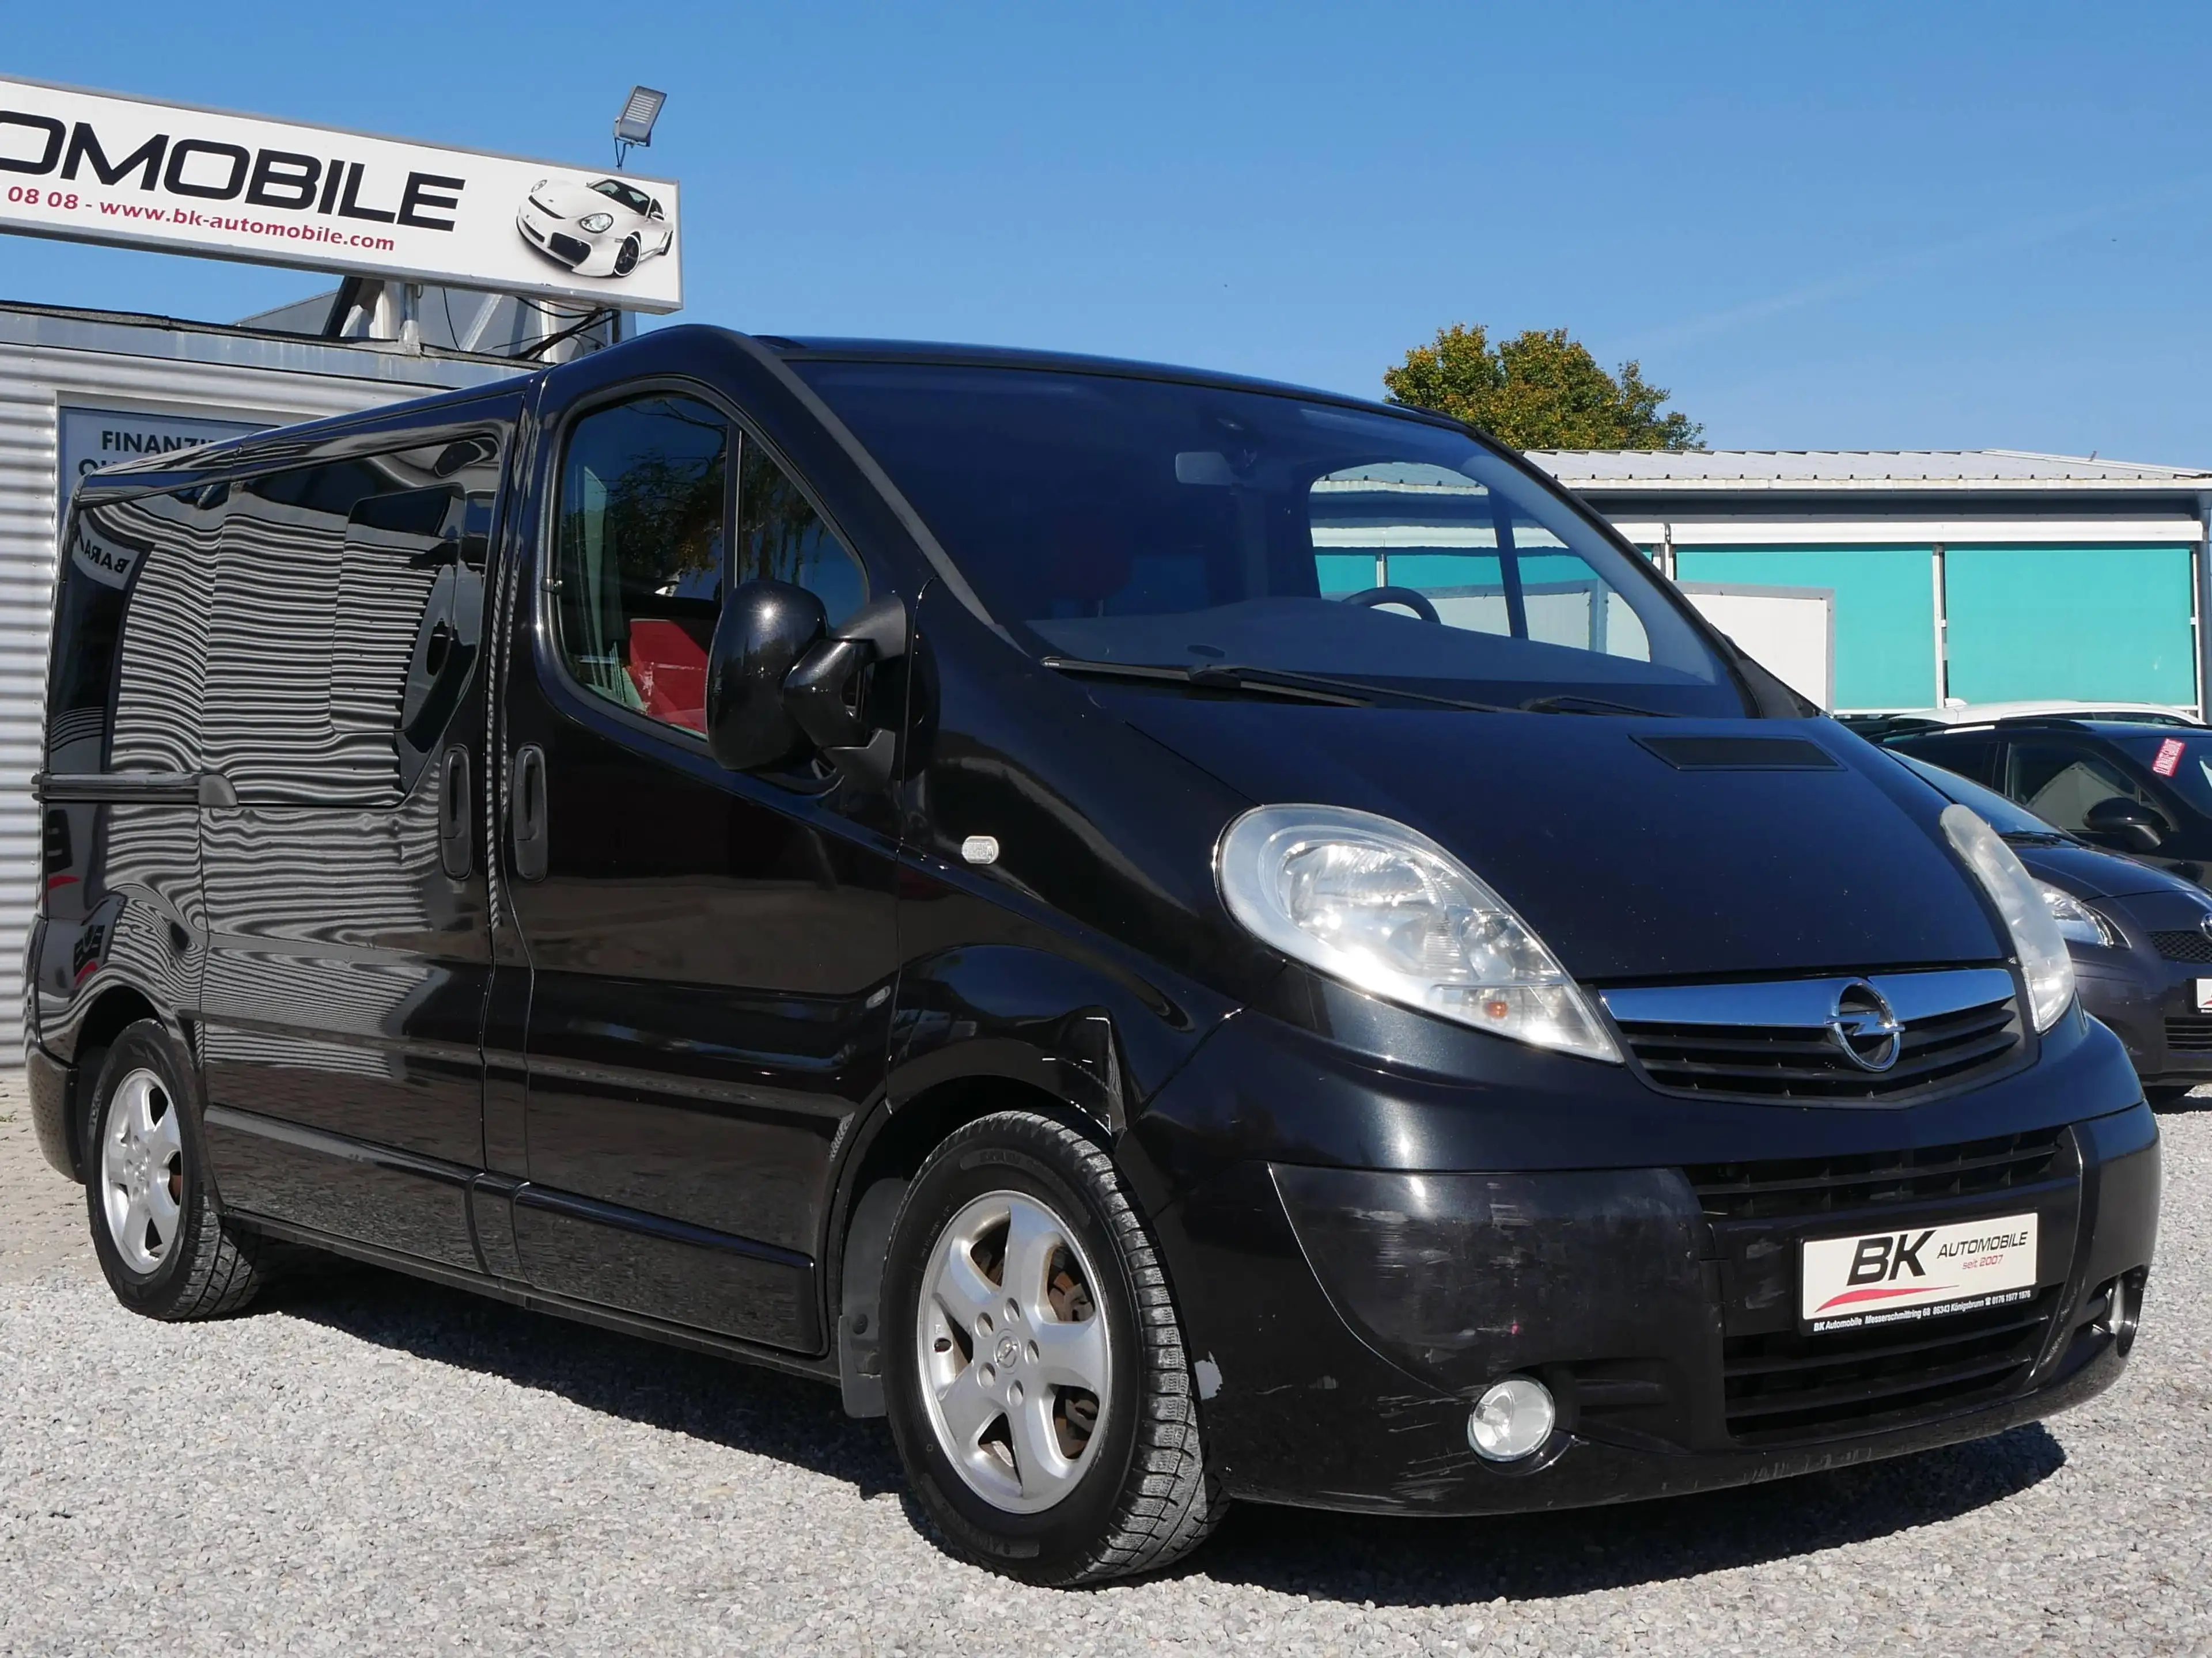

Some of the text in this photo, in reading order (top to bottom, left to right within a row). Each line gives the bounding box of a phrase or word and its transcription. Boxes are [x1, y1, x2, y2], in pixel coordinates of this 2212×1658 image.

[0, 110, 465, 232] OMOBILE
[8, 186, 40, 204] 08
[47, 192, 79, 210] 08
[100, 202, 395, 251] www.bk-automobile.com
[1846, 1230, 1937, 1286] BK
[1937, 1231, 2028, 1259] AUTOMOBILE
[1962, 1254, 2003, 1270] seit 2007
[1813, 1322, 1825, 1331] BK
[1825, 1316, 1862, 1330] Automobile
